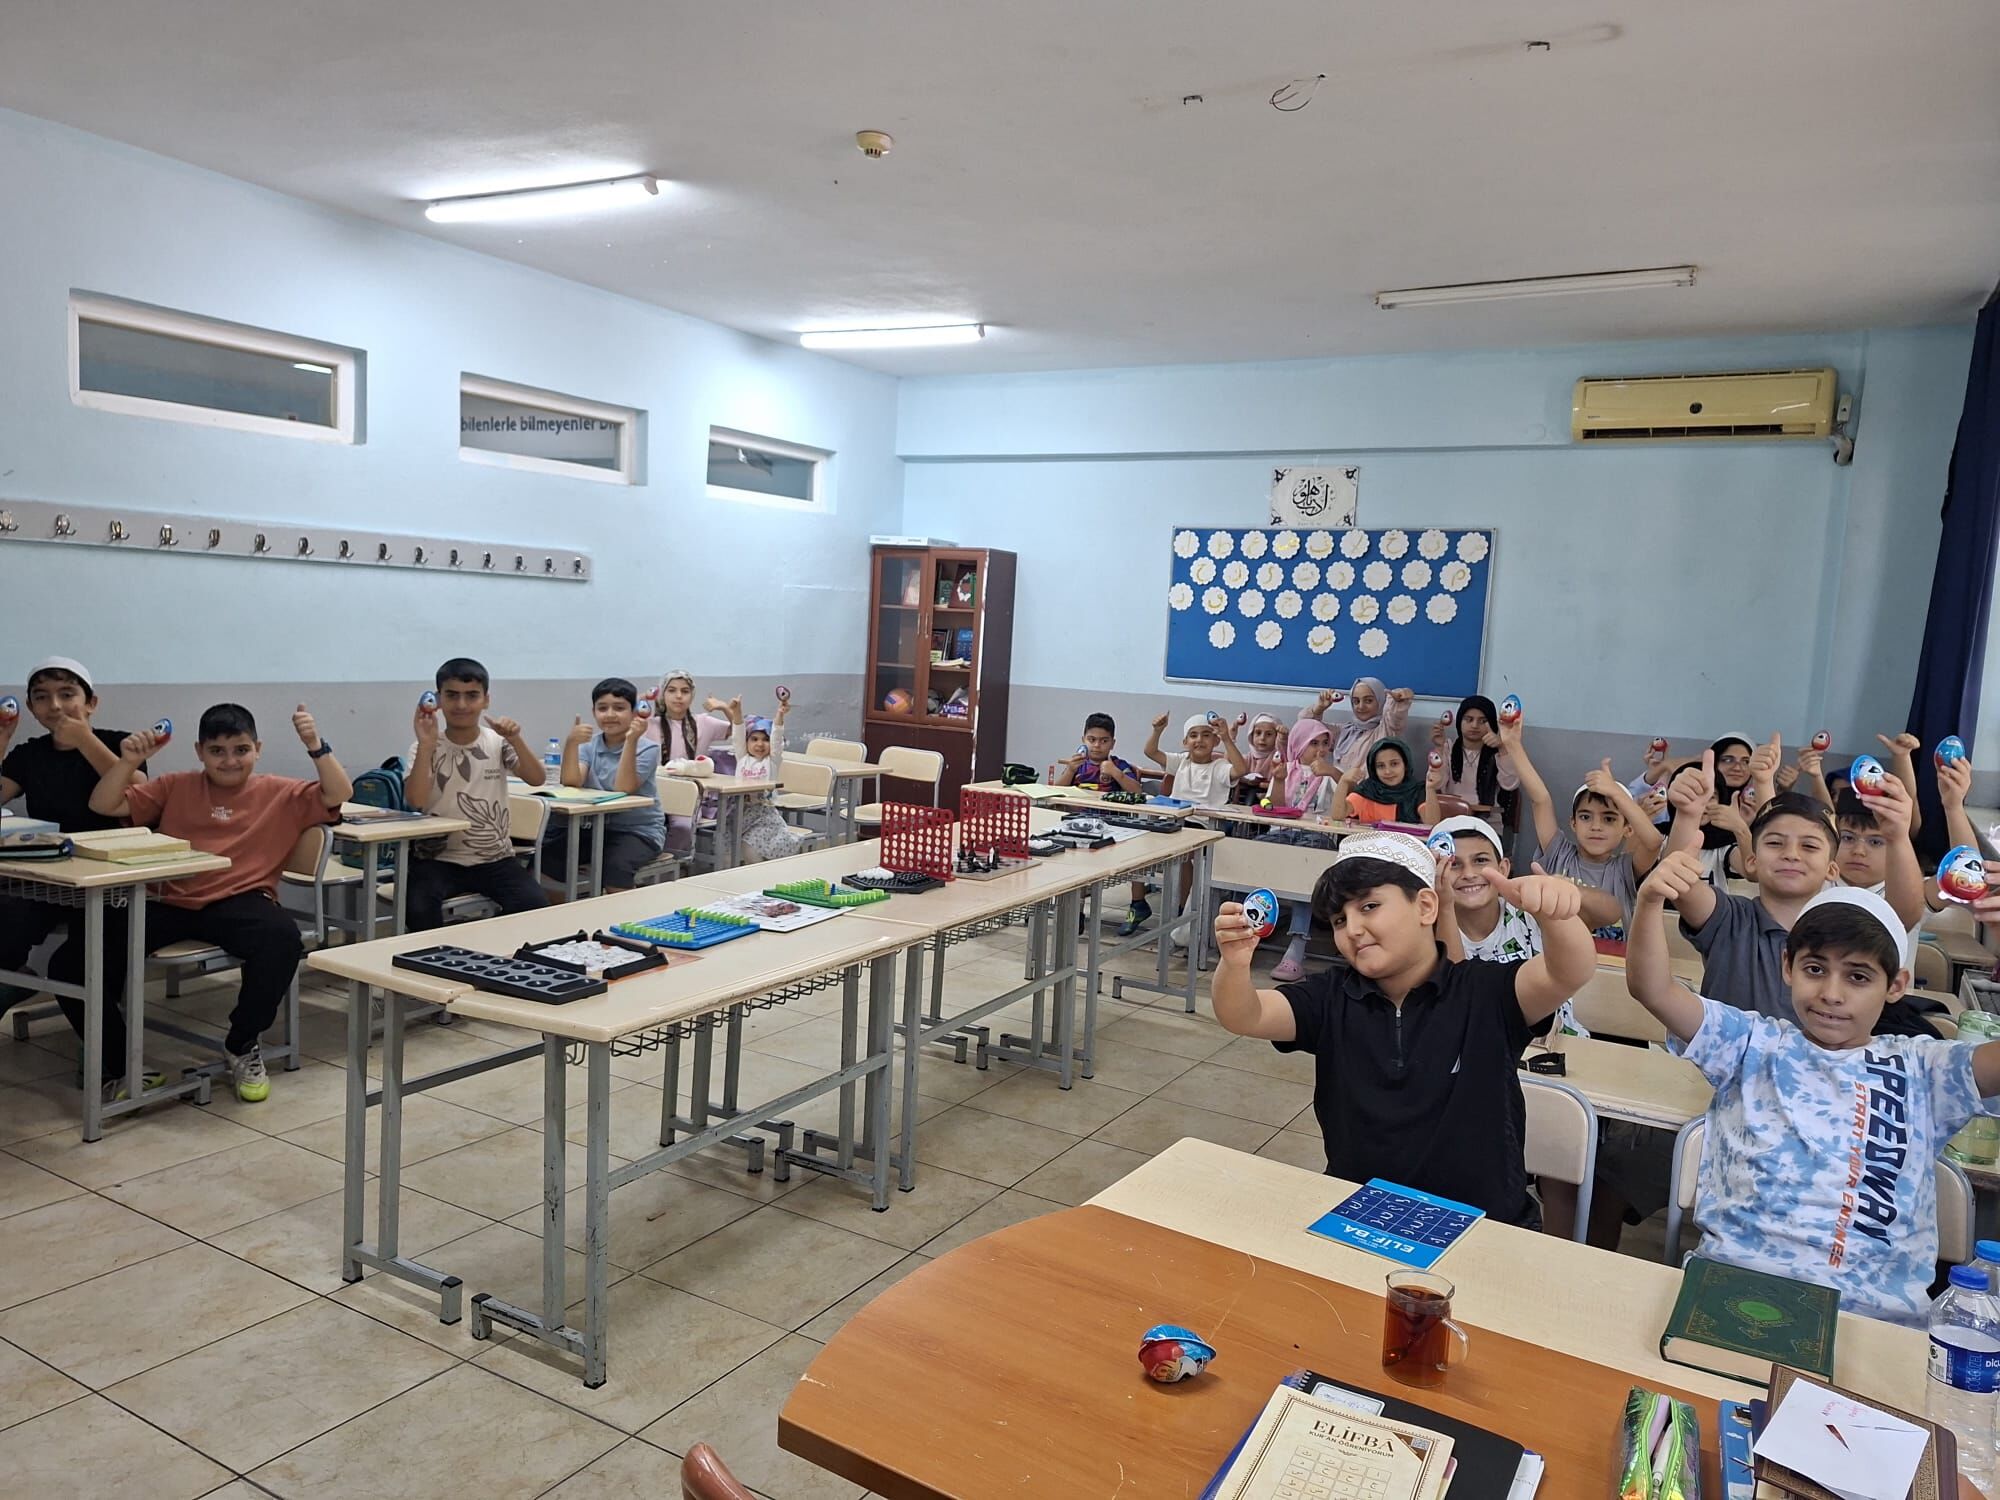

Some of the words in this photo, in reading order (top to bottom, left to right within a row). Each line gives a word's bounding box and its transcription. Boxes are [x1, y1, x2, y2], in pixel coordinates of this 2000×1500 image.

[461, 416, 516, 432] bilenlerle
[520, 415, 595, 435] bilmeyenler
[1852, 1081, 1867, 1141] START
[1843, 1144, 1864, 1189] YOUR
[1852, 1048, 1908, 1248] SPEEDWAY
